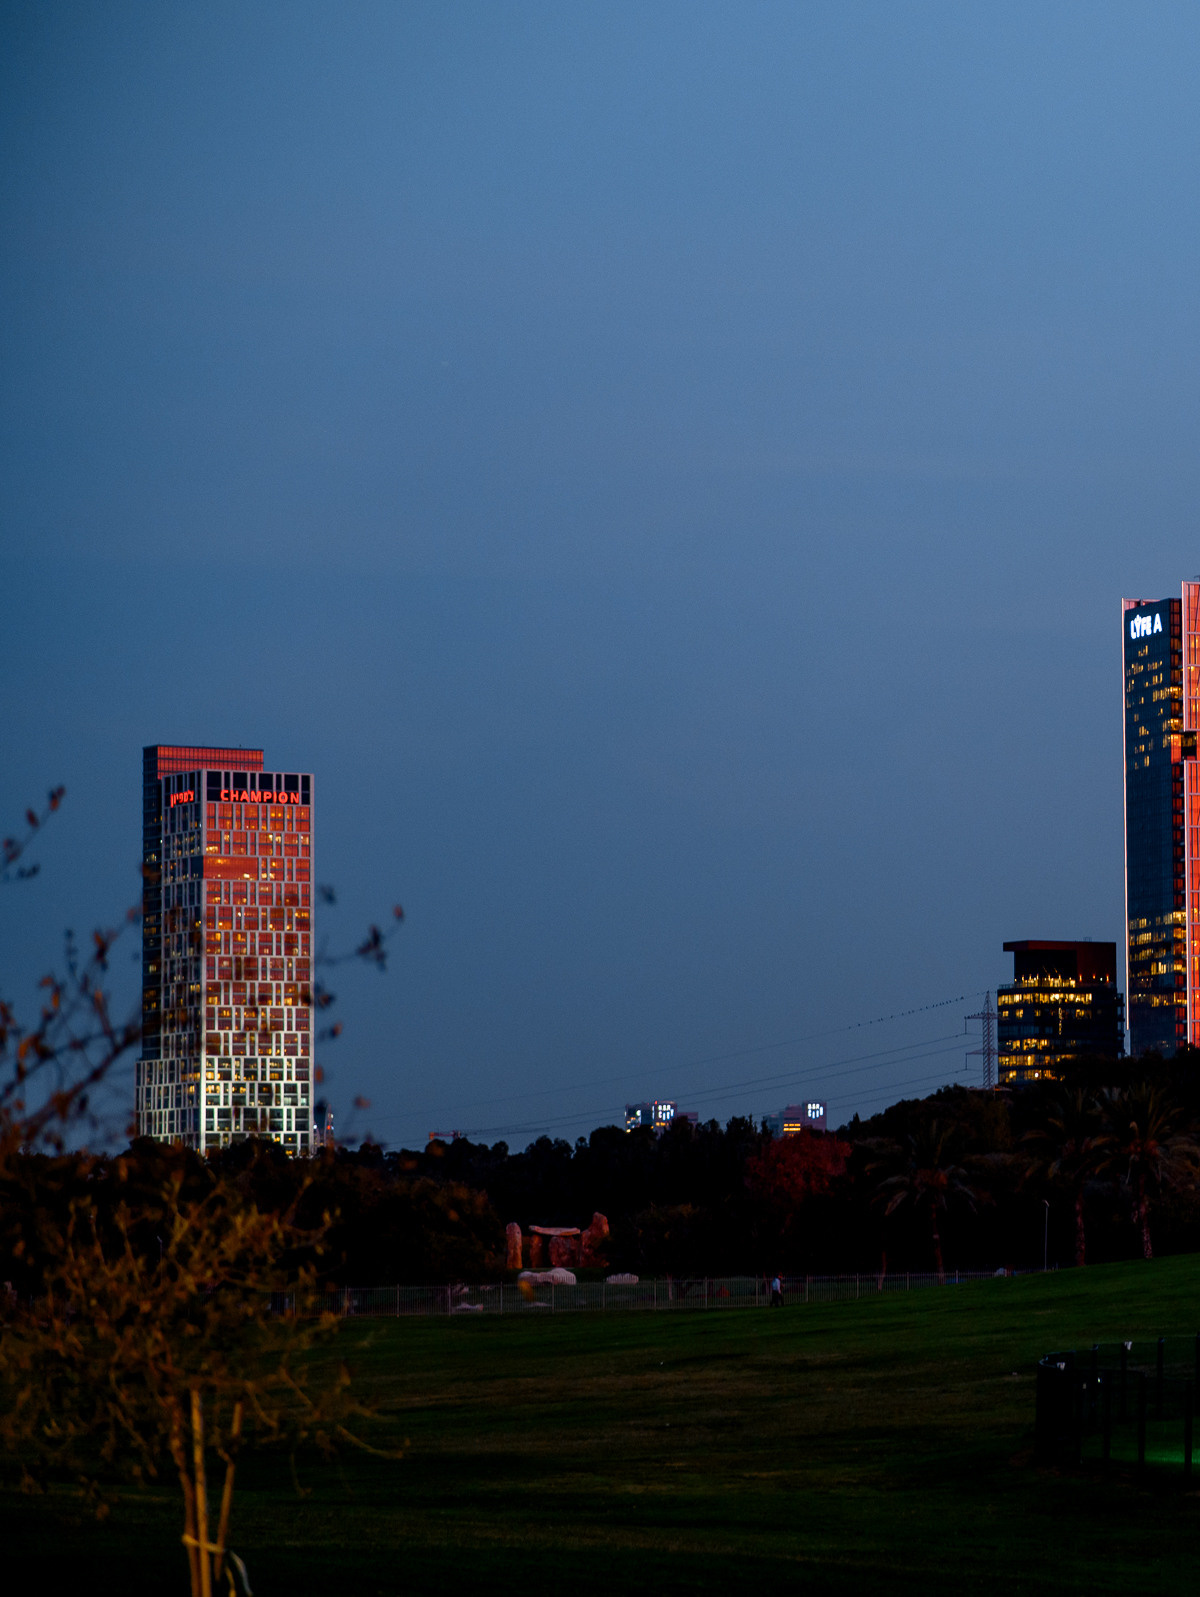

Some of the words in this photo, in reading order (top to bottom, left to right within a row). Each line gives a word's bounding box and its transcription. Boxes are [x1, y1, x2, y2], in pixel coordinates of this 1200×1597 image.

[1130, 614, 1152, 639] LYFE
[1153, 613, 1163, 634] A
[220, 789, 300, 805] CHAMPION
